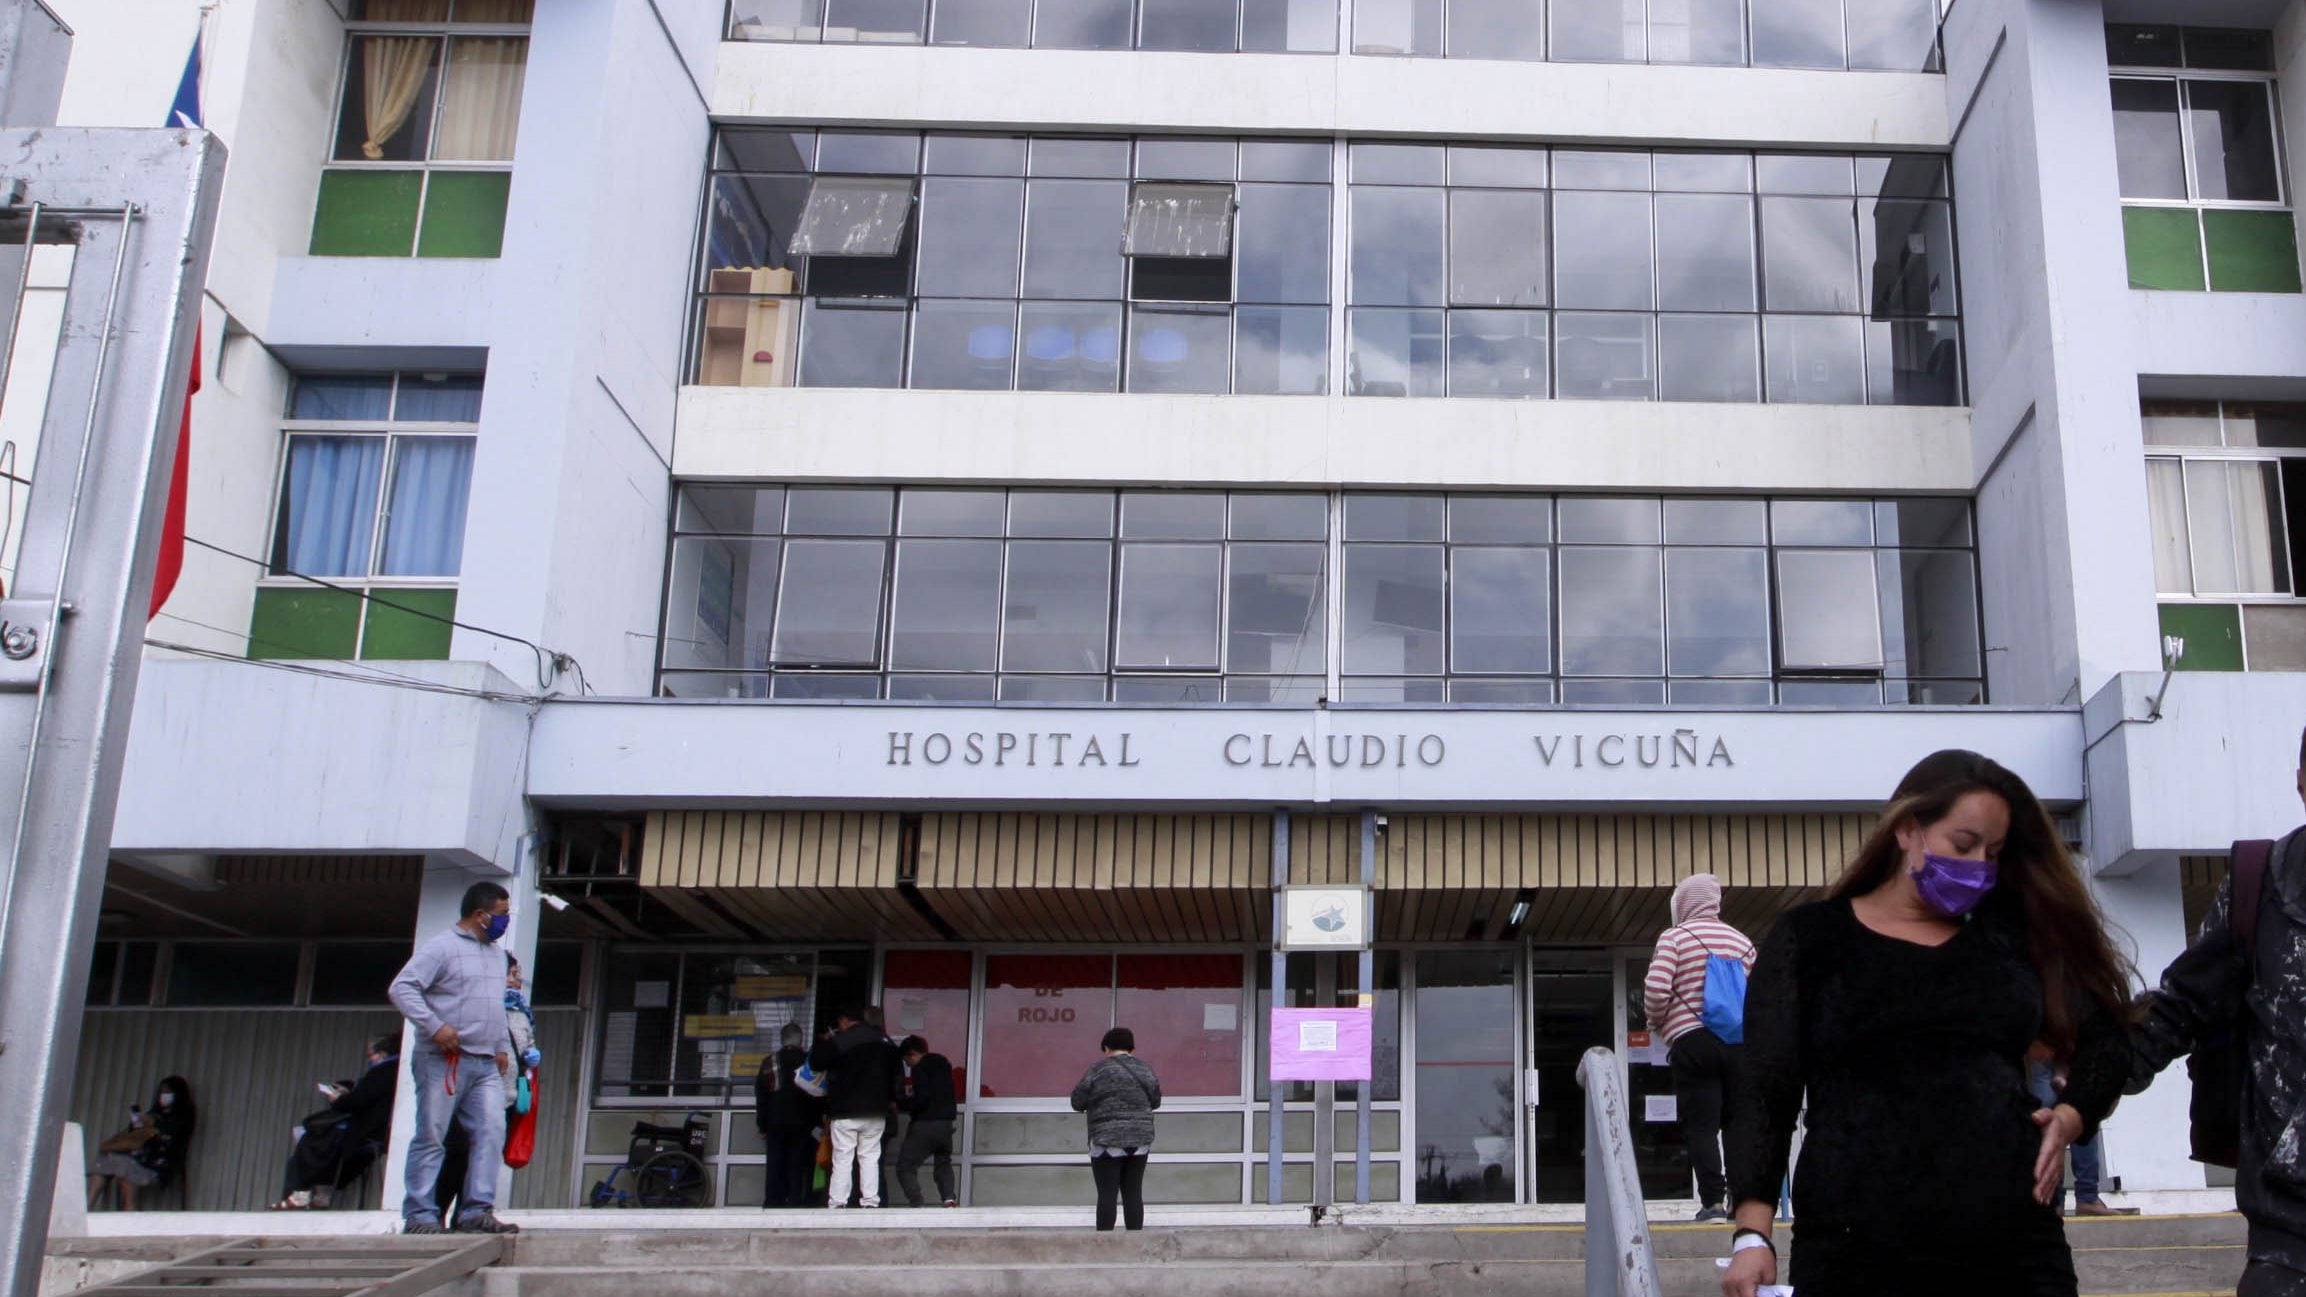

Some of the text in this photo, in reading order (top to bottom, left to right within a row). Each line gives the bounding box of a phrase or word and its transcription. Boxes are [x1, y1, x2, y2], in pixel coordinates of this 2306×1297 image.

[887, 728, 1735, 768] HOSPITAL CLAUDIO VICUÑA
[1017, 1007, 1076, 1023] ROJO
